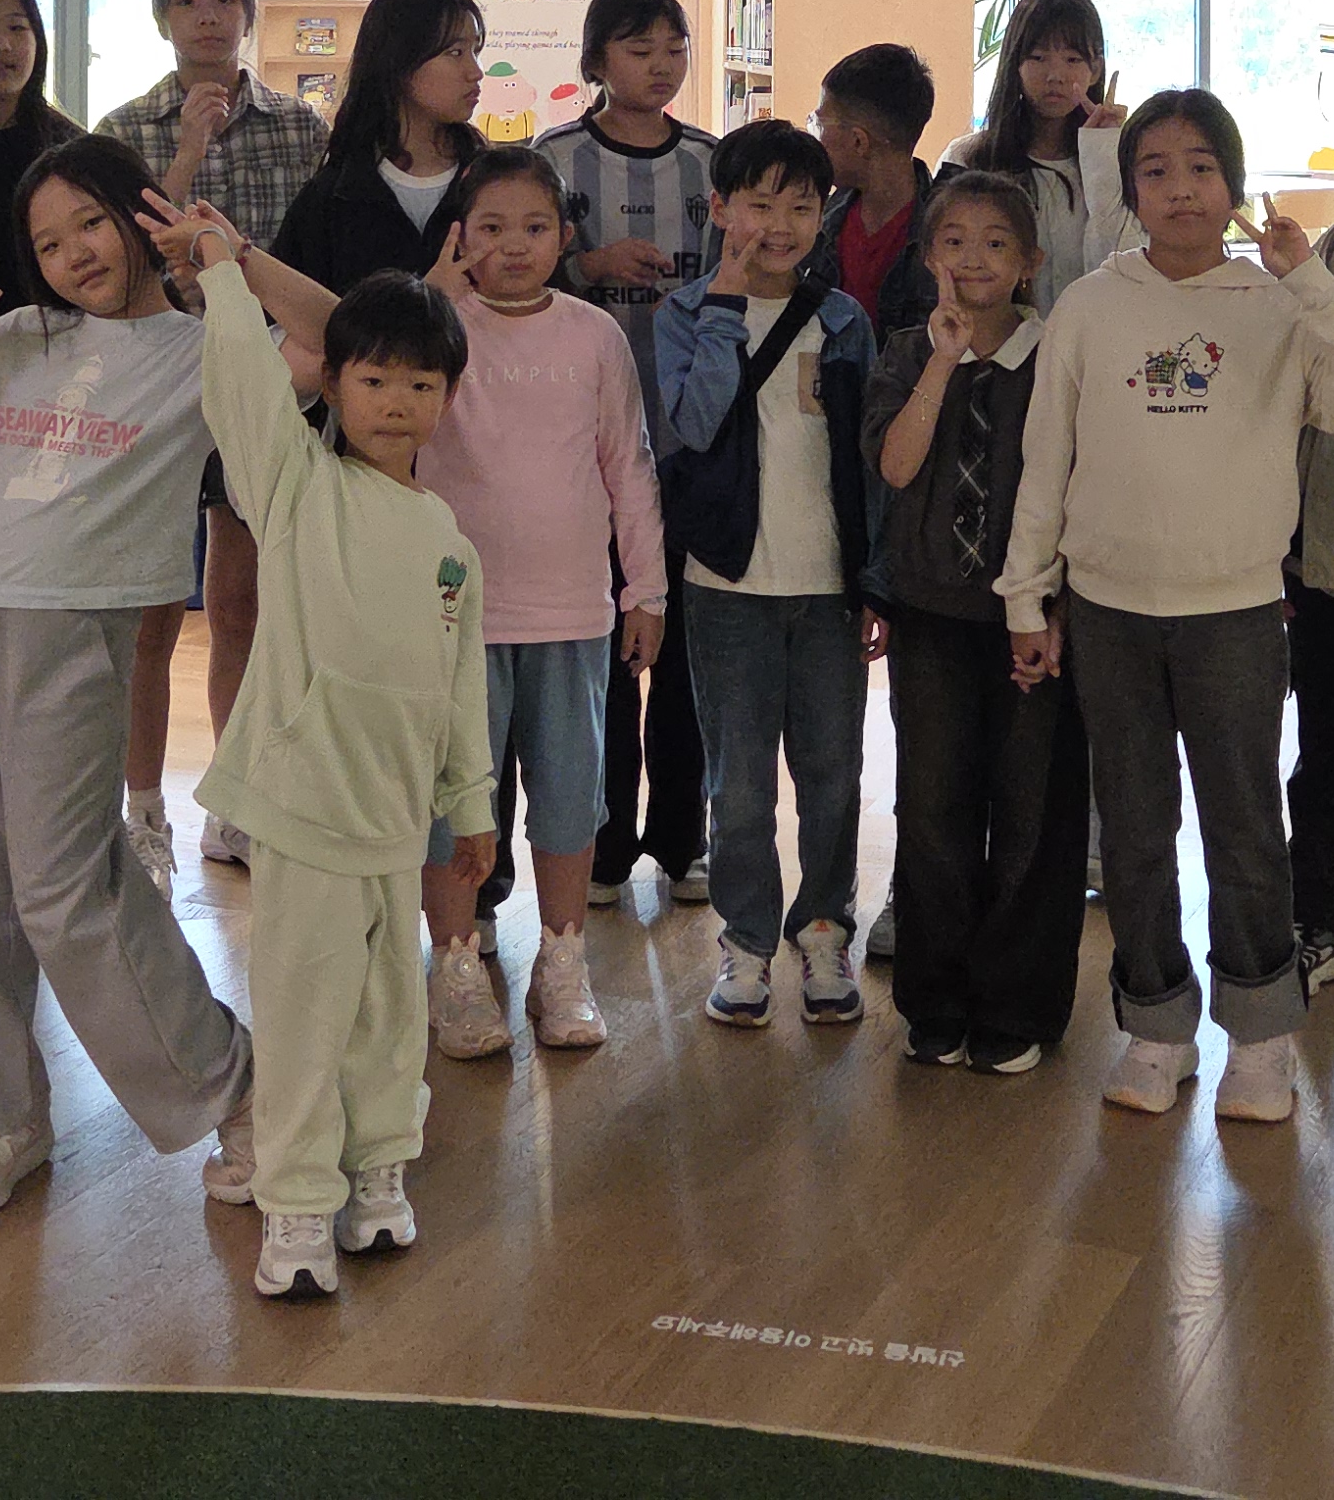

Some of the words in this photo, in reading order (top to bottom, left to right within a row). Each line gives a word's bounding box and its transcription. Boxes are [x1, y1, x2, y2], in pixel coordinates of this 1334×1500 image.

[620, 204, 655, 215] CALCIO
[465, 364, 579, 384] SIMPLE
[1147, 405, 1176, 413] HELLO
[1179, 405, 1208, 413] KITTY
[47, 440, 86, 455] MEETS
[651, 1315, 812, 1348] 이용해주세요
[820, 1335, 874, 1356] 벗고
[883, 1342, 965, 1368] 신발을
